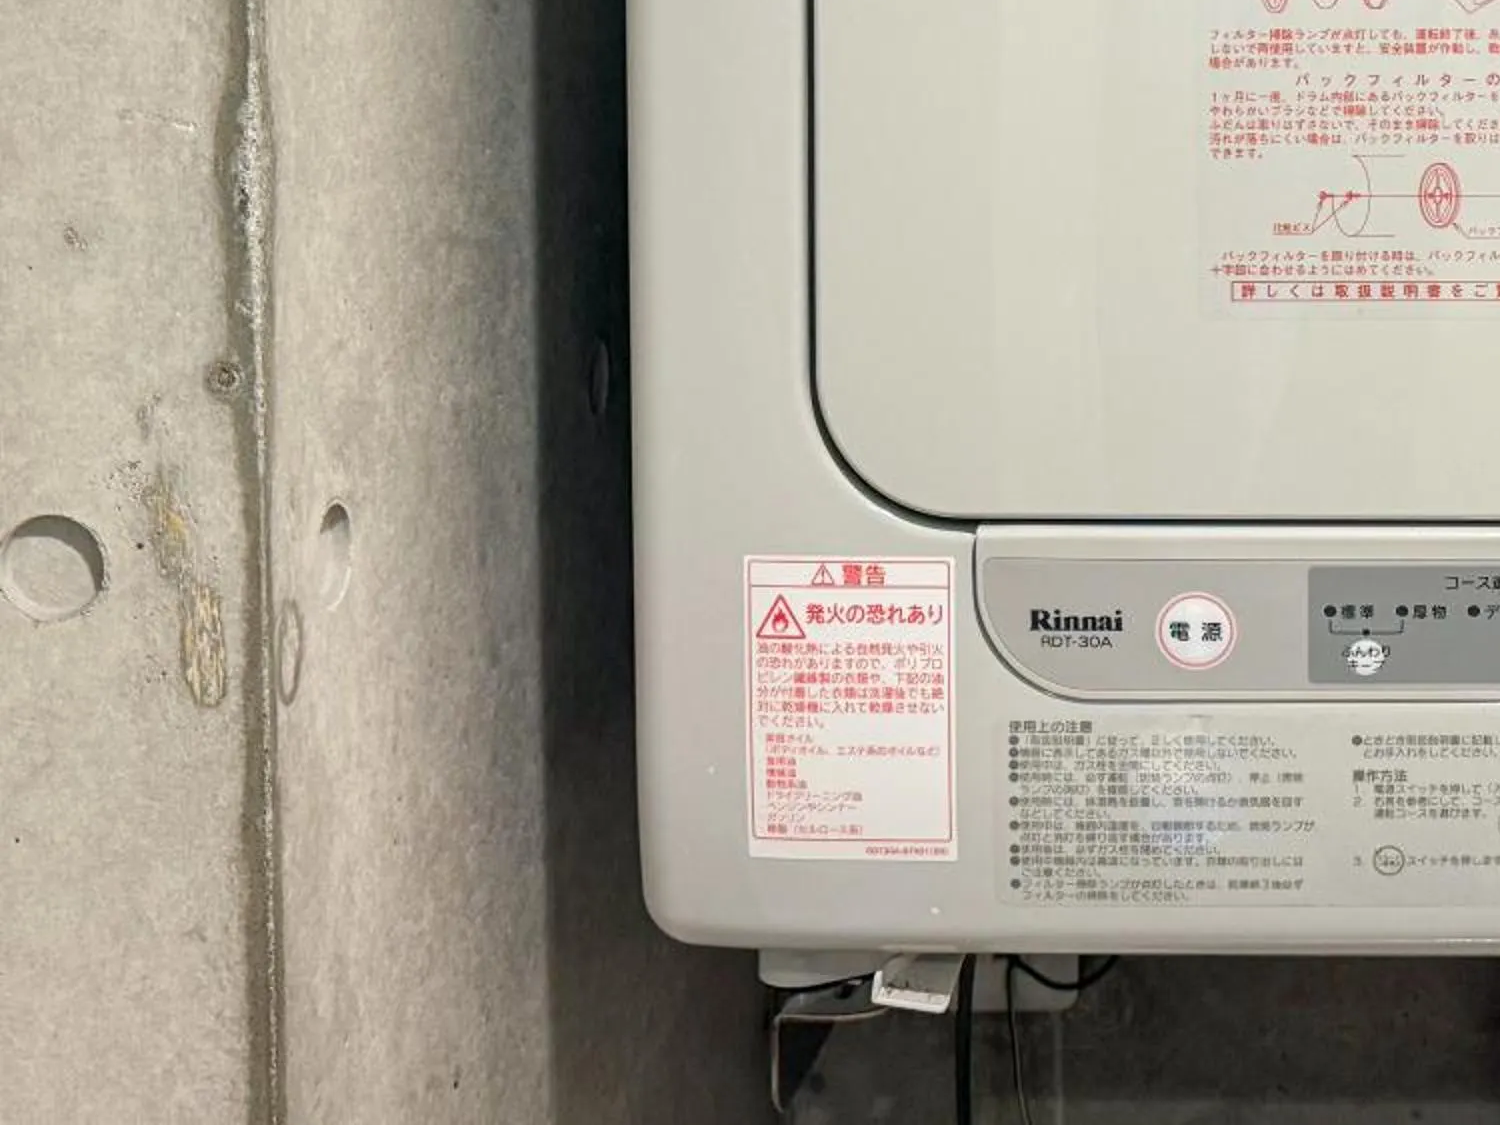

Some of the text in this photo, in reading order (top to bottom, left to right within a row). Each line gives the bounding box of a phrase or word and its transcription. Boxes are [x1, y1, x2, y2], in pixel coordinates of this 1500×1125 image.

[842, 564, 886, 586] 警告
[806, 604, 943, 624] 発火の恐れあり
[1340, 605, 1375, 619] 標準
[1413, 605, 1447, 619] 厚物
[1030, 609, 1124, 632] Rinnai
[1169, 622, 1224, 642] 電源
[1041, 636, 1113, 648] RDT-30A
[1341, 645, 1391, 658] ふんわり
[758, 715, 825, 729] でください。
[1009, 721, 1093, 734] 使用上の注意
